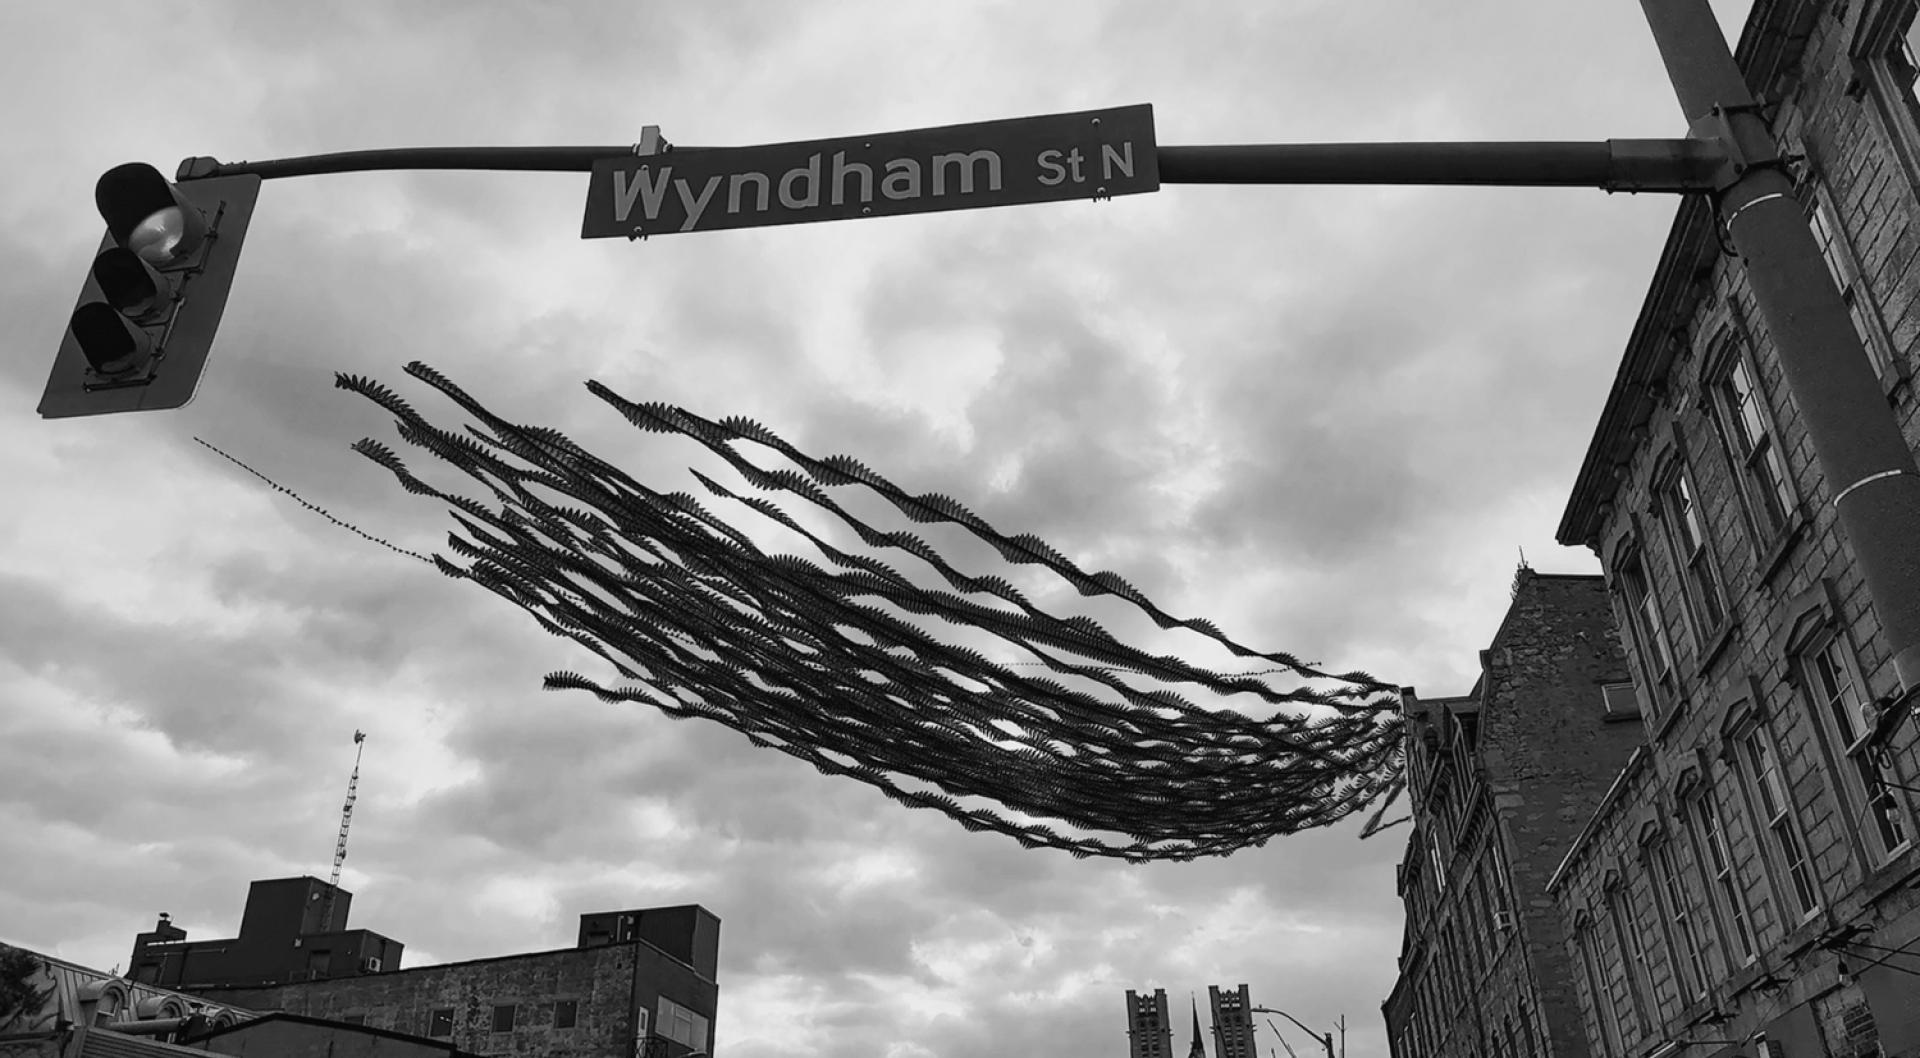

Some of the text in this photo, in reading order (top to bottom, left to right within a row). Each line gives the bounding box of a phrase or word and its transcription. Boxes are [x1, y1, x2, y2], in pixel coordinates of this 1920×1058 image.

[612, 141, 1135, 232] Wyndham St N
